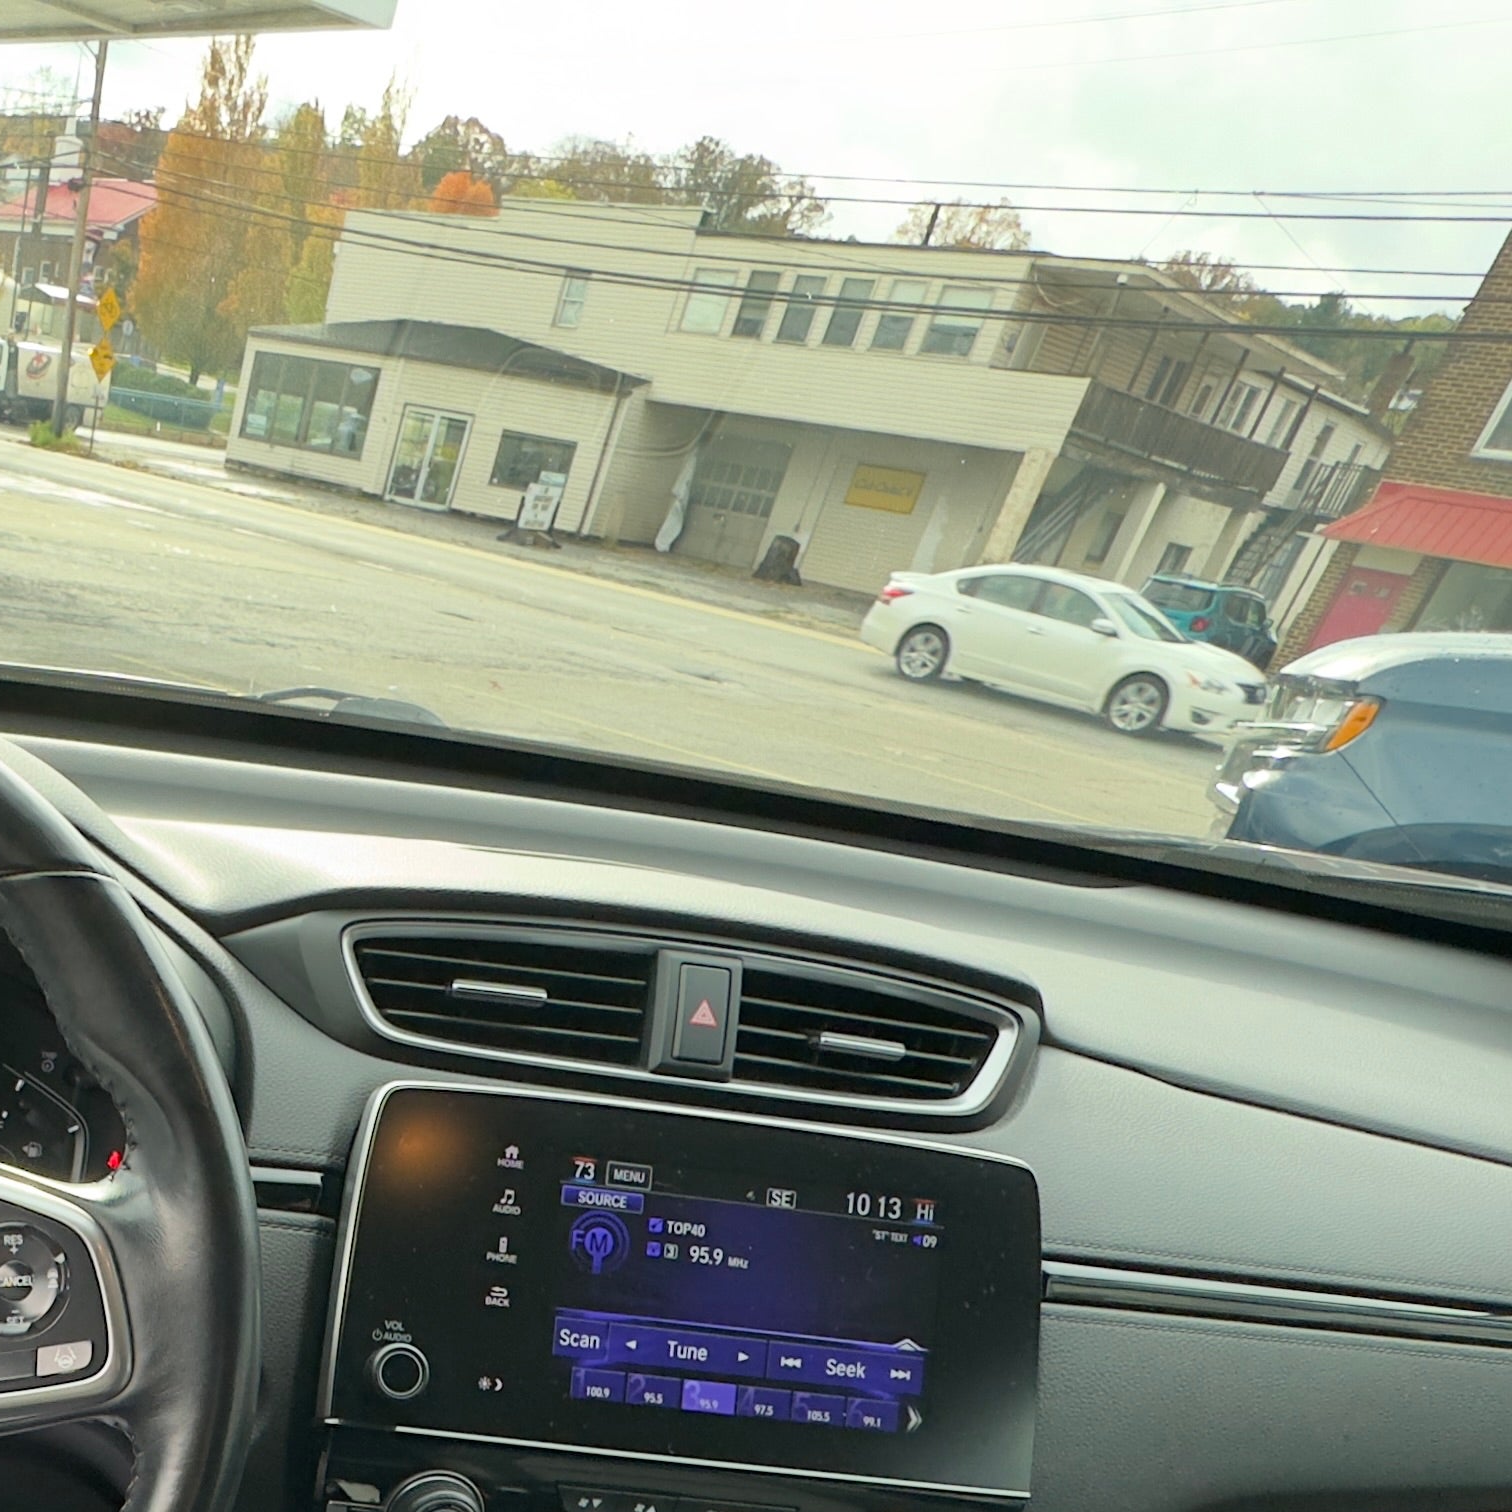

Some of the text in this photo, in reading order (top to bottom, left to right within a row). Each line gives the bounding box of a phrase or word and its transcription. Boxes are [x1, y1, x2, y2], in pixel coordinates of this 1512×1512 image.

[497, 1158, 524, 1170] HOME
[573, 1160, 595, 1181] 73
[613, 1168, 646, 1184] MENU
[770, 1191, 791, 1206] SE
[915, 1203, 935, 1223] Hi
[577, 1191, 628, 1209] SOURCE
[492, 1203, 521, 1216] AUDIO
[666, 1220, 706, 1238] TOP40
[3, 1234, 24, 1246] RES
[921, 1234, 938, 1249] 09
[486, 1252, 517, 1265] PHONE
[689, 1247, 749, 1270] 95.9 MHz
[484, 1296, 511, 1308] BACK
[384, 1319, 405, 1331] VOL
[383, 1332, 412, 1344] AUDIO
[559, 1328, 600, 1350] Scan
[667, 1340, 708, 1362] Tune
[825, 1359, 867, 1380] Seek
[585, 1385, 611, 1399] 100.9
[643, 1391, 664, 1405] 95.5
[699, 1398, 719, 1410] 95.9
[753, 1404, 774, 1417] 97.5
[806, 1410, 831, 1423] 105.5
[862, 1415, 882, 1428] 99.1
